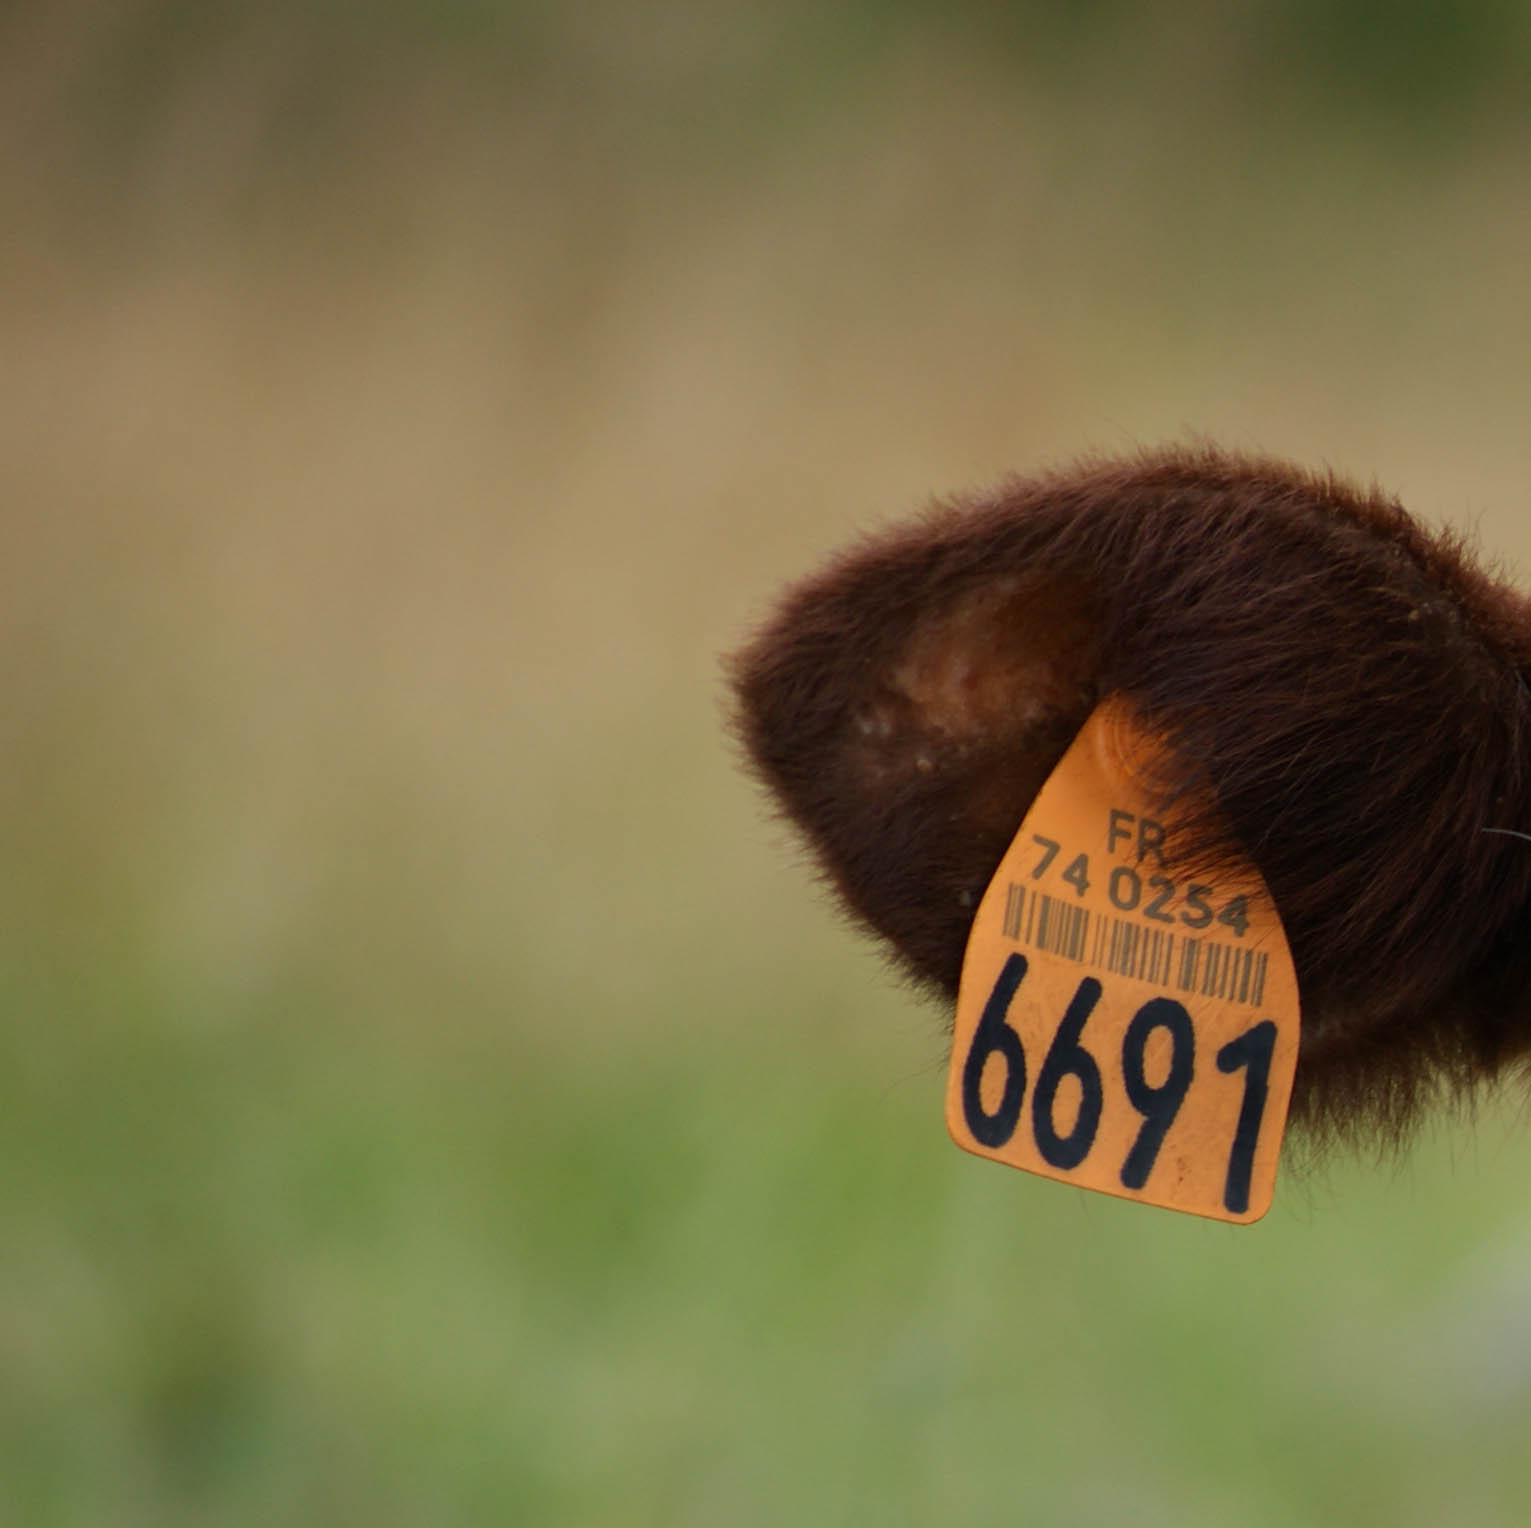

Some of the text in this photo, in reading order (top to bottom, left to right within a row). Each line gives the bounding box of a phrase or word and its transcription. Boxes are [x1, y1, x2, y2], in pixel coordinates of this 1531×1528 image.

[1032, 834, 1250, 938] 74 0254
[1107, 808, 1168, 868] FR
[963, 952, 1278, 1214] 6691
